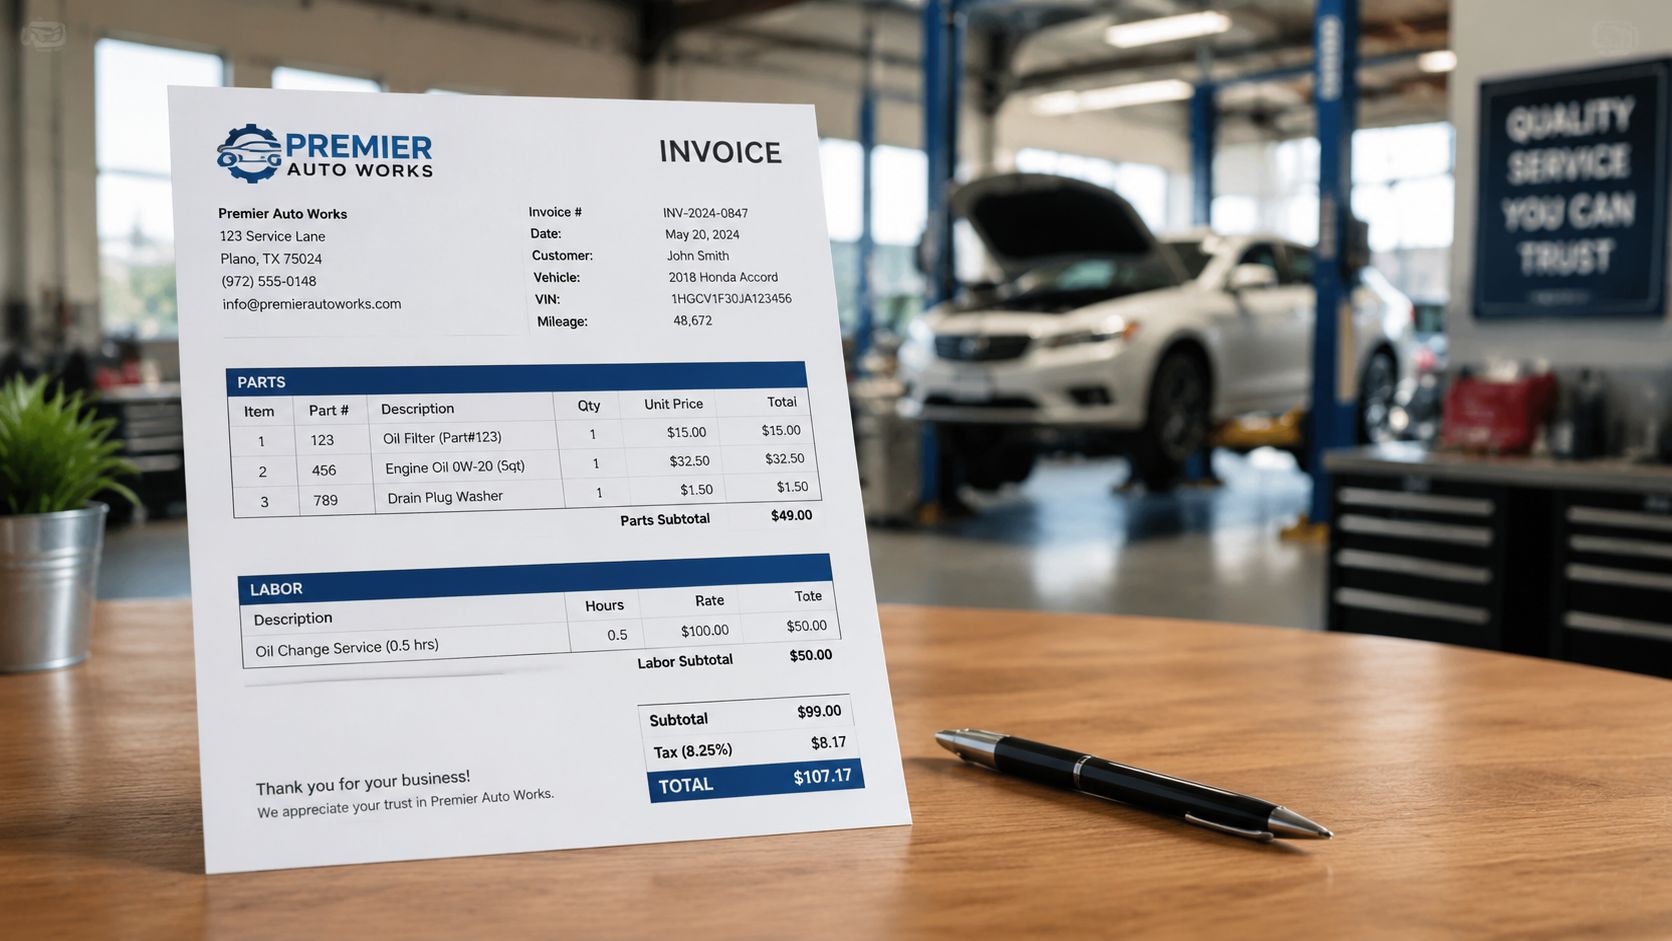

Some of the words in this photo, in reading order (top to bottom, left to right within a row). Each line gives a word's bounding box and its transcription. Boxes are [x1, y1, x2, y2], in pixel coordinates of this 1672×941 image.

[1506, 96, 1635, 144] QUALITY
[286, 133, 433, 160] PREMIER
[659, 139, 782, 164] INVOICE
[287, 162, 347, 177] AUTO
[356, 163, 433, 178] WORKS
[1507, 143, 1631, 186] SERVICE
[218, 208, 269, 220] Premier
[272, 208, 304, 220] Auto
[307, 208, 348, 220] Works
[528, 206, 571, 218] Invoice
[574, 206, 582, 217] #
[663, 207, 749, 219] INV-2024-0847
[1501, 195, 1566, 232] YOU
[1567, 191, 1635, 229] CAN
[220, 230, 242, 242] 123
[246, 230, 292, 242] Service
[295, 230, 326, 242] Lane
[530, 228, 562, 240] Date:
[665, 229, 690, 242] May
[692, 229, 710, 242] 20,
[712, 229, 740, 240] 2024
[220, 252, 260, 267] Plano,
[262, 252, 281, 265] TX
[283, 252, 323, 265] 75024
[532, 250, 593, 262] Customer:
[667, 250, 694, 262] John
[697, 250, 730, 262] Smith
[1516, 238, 1616, 276] TRUST
[221, 274, 254, 289] (972)
[257, 275, 317, 288] 555-0148
[533, 271, 581, 284] Vehicle:
[669, 271, 697, 283] 2018
[699, 271, 737, 283] Honda
[739, 271, 779, 283] Accord
[222, 297, 402, 312] info@premierautoworks.com
[535, 293, 561, 305] VIN:
[671, 292, 793, 305] 1HGCV1F30JA123456
[537, 315, 588, 330] Mileage:
[673, 315, 713, 328] 48,672
[237, 376, 286, 388] PARTS
[309, 404, 339, 416] Part
[340, 404, 349, 416] #
[381, 402, 455, 416] Description
[577, 399, 601, 413] Qty
[644, 398, 671, 411] Unit
[673, 397, 704, 410] Price
[244, 405, 275, 418] Item
[590, 429, 596, 440] 1
[667, 426, 707, 439] $15.00
[762, 424, 801, 437] $15.00
[258, 436, 265, 447] 1
[311, 434, 335, 446] 123
[383, 432, 401, 445] Oil
[404, 432, 436, 444] Filter
[439, 430, 502, 445] (Part#123)
[593, 458, 599, 469] 1
[669, 455, 710, 468] $32.50
[765, 452, 805, 465] $32.50
[258, 466, 267, 478] 2
[312, 464, 337, 476] 456
[386, 462, 429, 477] Engine
[432, 461, 449, 474] Oil
[452, 460, 494, 473] 0W-20
[597, 487, 602, 499] 1
[680, 484, 714, 497] $1.50
[777, 481, 809, 494] $1.50
[260, 496, 269, 508] 3
[313, 494, 338, 506] 789
[388, 492, 422, 505] Drain
[425, 491, 453, 506] Plug
[455, 490, 504, 503] Washer
[620, 514, 655, 527] Parts
[657, 512, 711, 526] Subtotal
[771, 509, 813, 522] $49.00
[250, 582, 303, 596] LABOR
[585, 600, 625, 612] Hours
[695, 594, 725, 607] Rate
[254, 611, 333, 627] Description
[681, 624, 730, 638] $100.00
[786, 619, 828, 633] $50.00
[607, 629, 628, 641] 0.5
[255, 645, 274, 658] Oil
[278, 643, 330, 659] Change
[333, 641, 382, 655] Service
[385, 639, 411, 654] (0.5
[413, 638, 440, 653] hrs)
[789, 648, 833, 662] $50.00
[638, 656, 676, 669] Labor
[678, 653, 734, 667] Subtotal
[797, 704, 842, 719] $99.00
[649, 712, 709, 727] Subtotal
[811, 735, 847, 750] $8.17
[653, 746, 679, 759] Tax
[681, 742, 733, 759] (8.25%)
[256, 781, 304, 797] Thank
[306, 783, 335, 796] you
[338, 776, 360, 791] for
[364, 775, 398, 791] your
[401, 769, 471, 787] business!
[793, 767, 852, 786] $107.17
[658, 777, 714, 794] TOTAL
[257, 807, 279, 819] We
[282, 803, 349, 819] appreciate
[352, 801, 381, 815] your
[384, 799, 413, 810] trust
[415, 797, 428, 808] in
[430, 793, 478, 807] Premier
[481, 791, 511, 804] Auto
[513, 787, 555, 801] Works.
